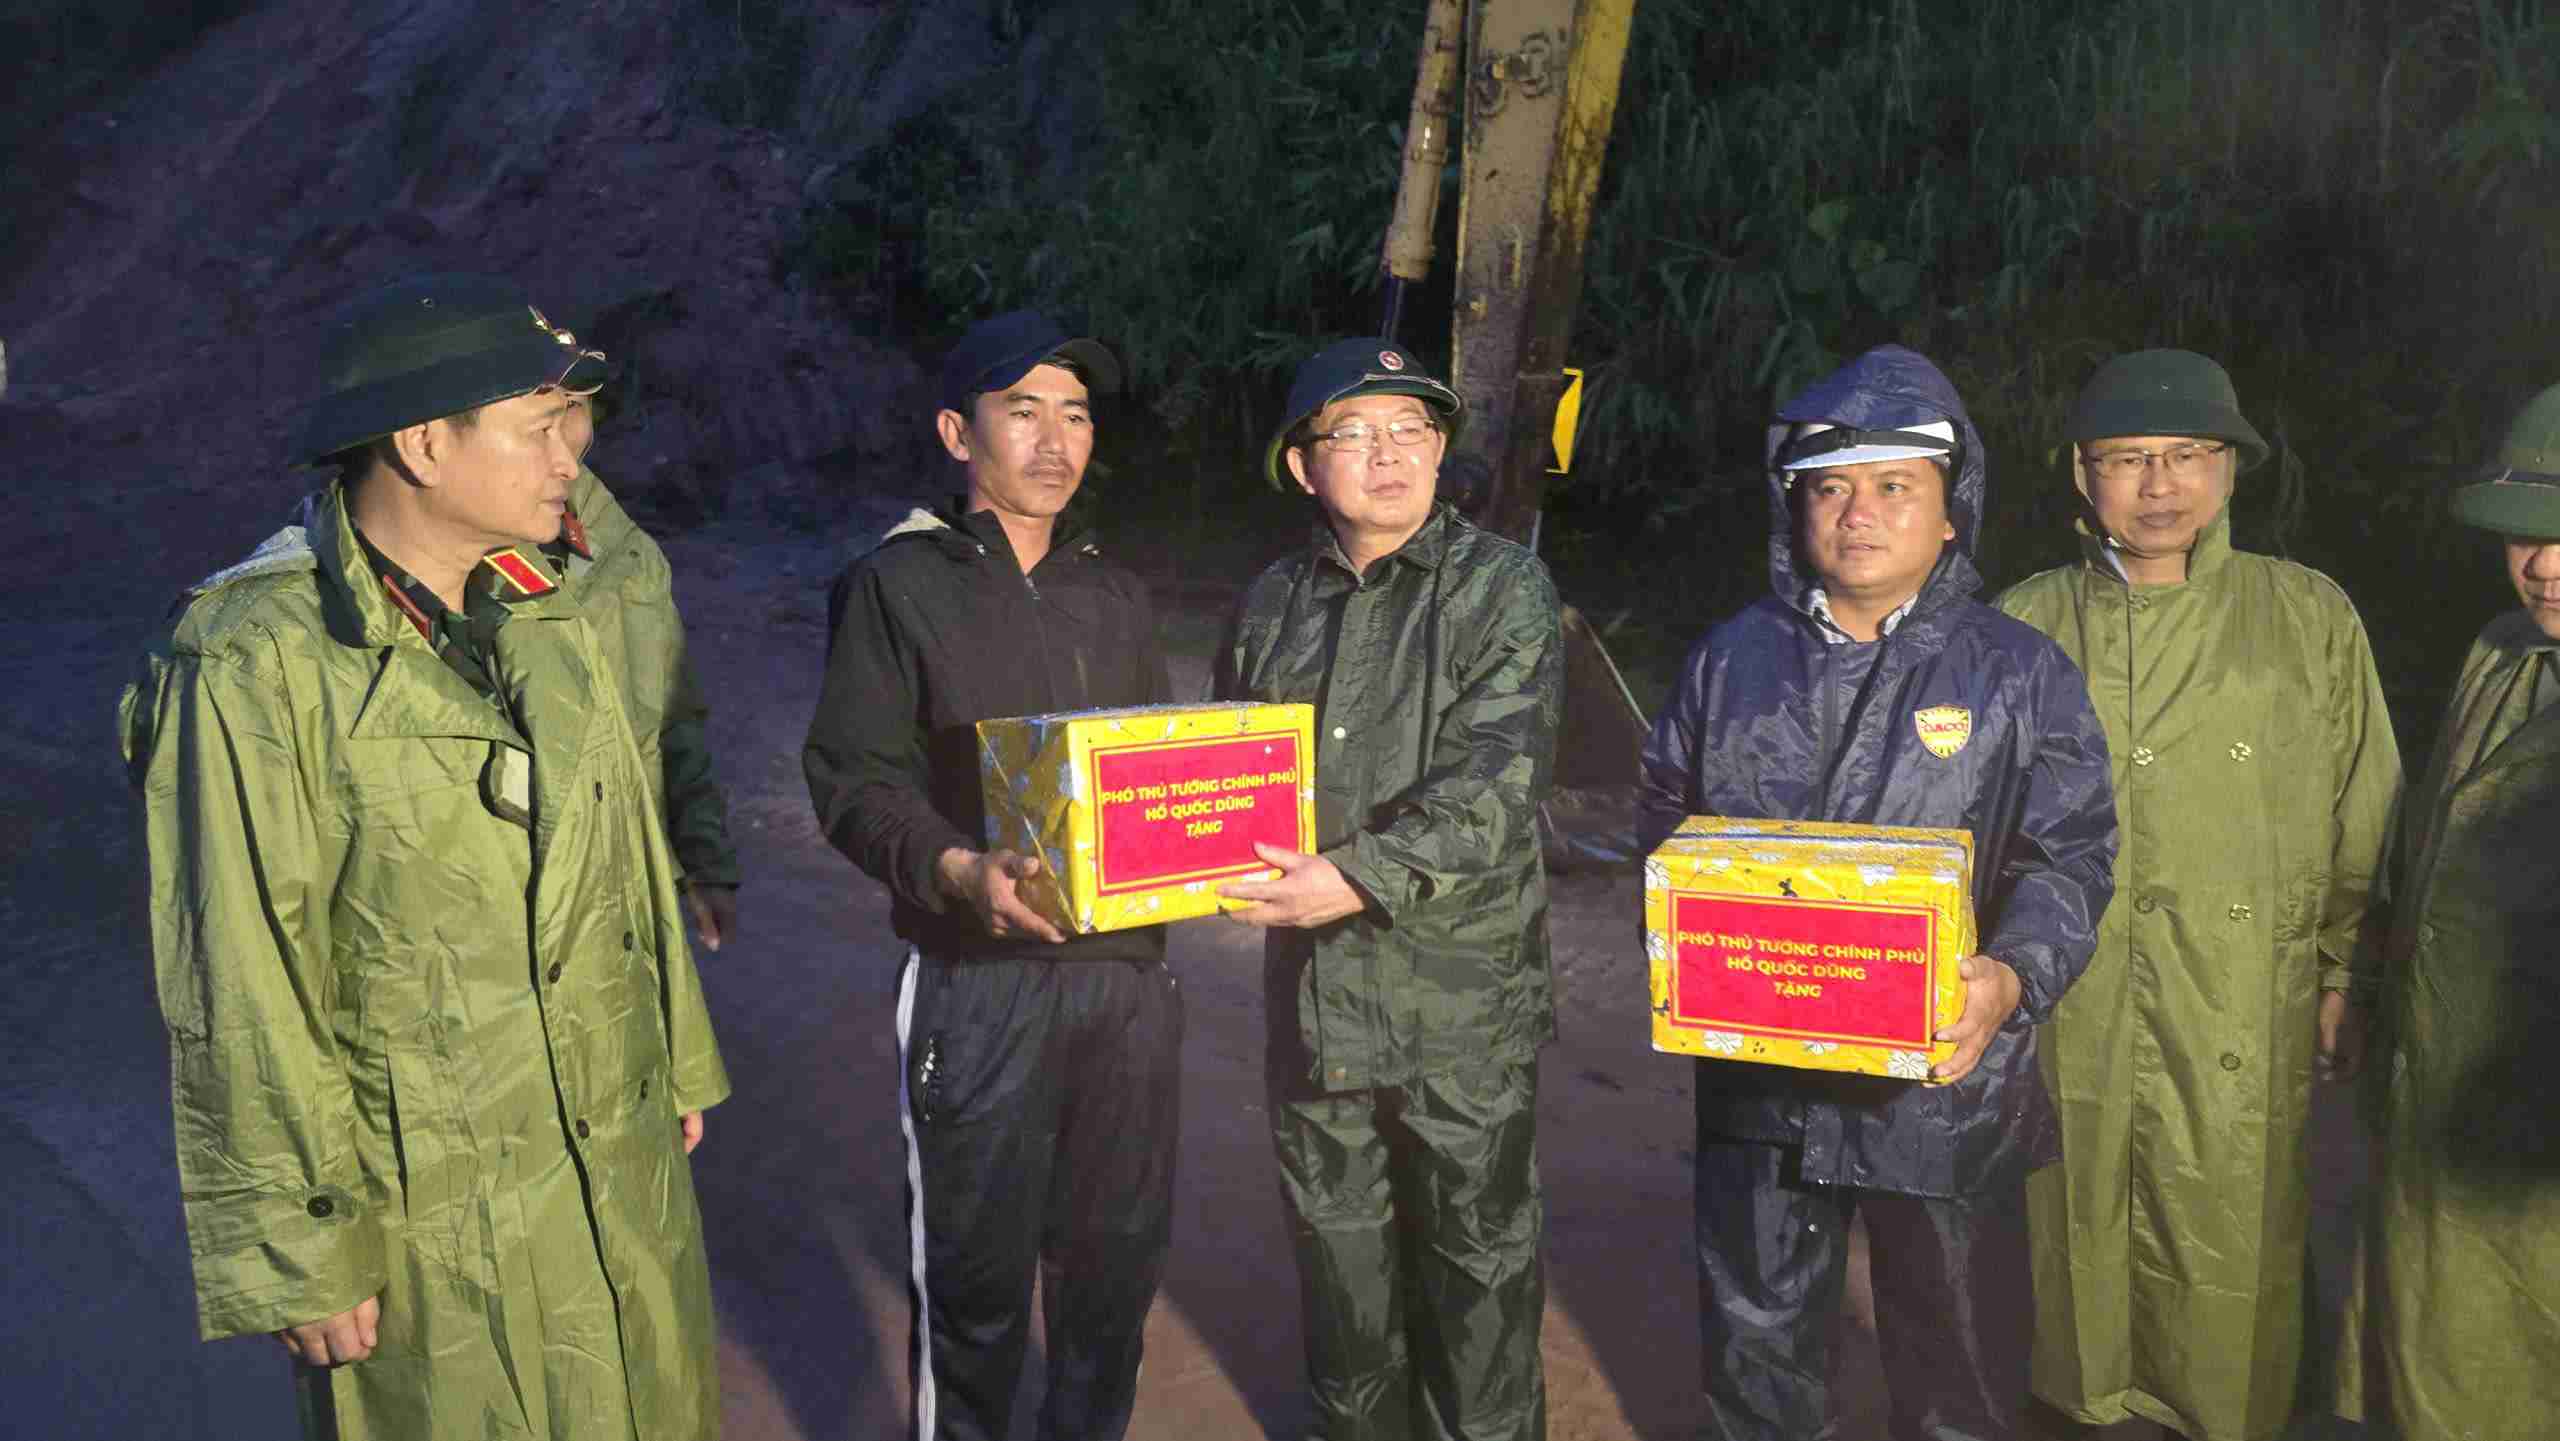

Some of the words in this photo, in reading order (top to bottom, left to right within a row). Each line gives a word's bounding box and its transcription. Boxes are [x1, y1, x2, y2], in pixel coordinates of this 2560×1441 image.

[1102, 787, 1134, 805] PHÓ
[1137, 781, 1167, 801] THỦ
[1171, 778, 1219, 797] TƯỚNG
[1221, 774, 1265, 791] CHÍNH
[1268, 768, 1296, 785] PHỦ
[1171, 800, 1212, 819] QUỐC
[1216, 795, 1254, 812] DŨNG
[1186, 820, 1222, 839] TẶNG
[1678, 930, 1714, 946] PHÓ
[1719, 933, 1753, 950] THỦ
[1757, 937, 1818, 957] TƯỚNG
[1823, 942, 1880, 961] CHÍNH
[1886, 947, 1925, 964] PHỦ
[1757, 958, 1808, 977] QUỐC
[1813, 962, 1866, 980] DŨNG
[1775, 981, 1822, 999] TẶNG
